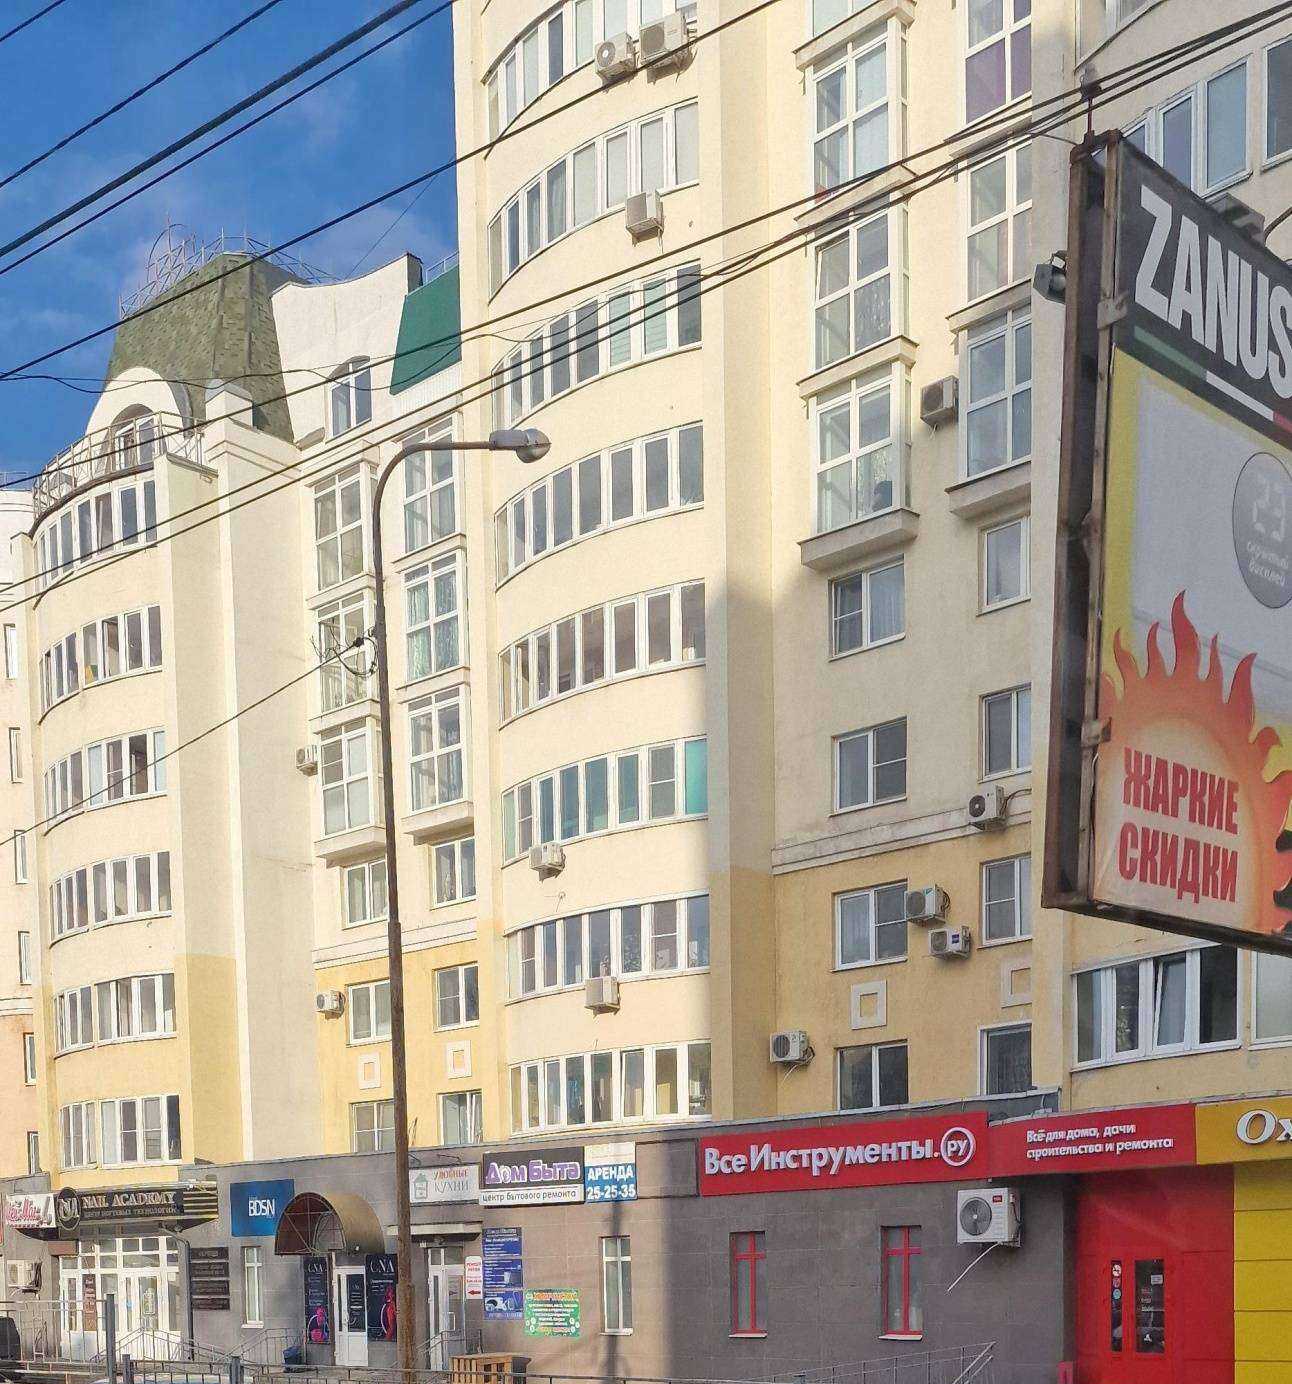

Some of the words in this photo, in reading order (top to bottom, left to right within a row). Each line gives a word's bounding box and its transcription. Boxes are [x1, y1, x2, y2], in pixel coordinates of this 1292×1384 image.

[1123, 747, 1239, 834] ЖАРКИЕ
[1118, 822, 1238, 903] СКИДКИ
[1045, 1130, 1065, 1143] для
[1066, 1128, 1101, 1141] дома,
[1103, 1124, 1136, 1138] дачи
[1027, 1142, 1102, 1161] строительства
[1105, 1142, 1114, 1152] и
[1116, 1138, 1173, 1156] ремонта
[485, 1162, 528, 1185] Дом
[528, 1159, 581, 1181] Быта
[587, 1165, 634, 1181] АРЕНДА
[434, 1180, 469, 1194] КУХНИ
[482, 1193, 505, 1202] центр
[506, 1191, 540, 1201] бытового
[542, 1190, 577, 1200] ремонта
[587, 1184, 636, 1199] 25-25-35
[82, 1195, 109, 1208] NAIL
[112, 1191, 176, 1207] ACADEMY
